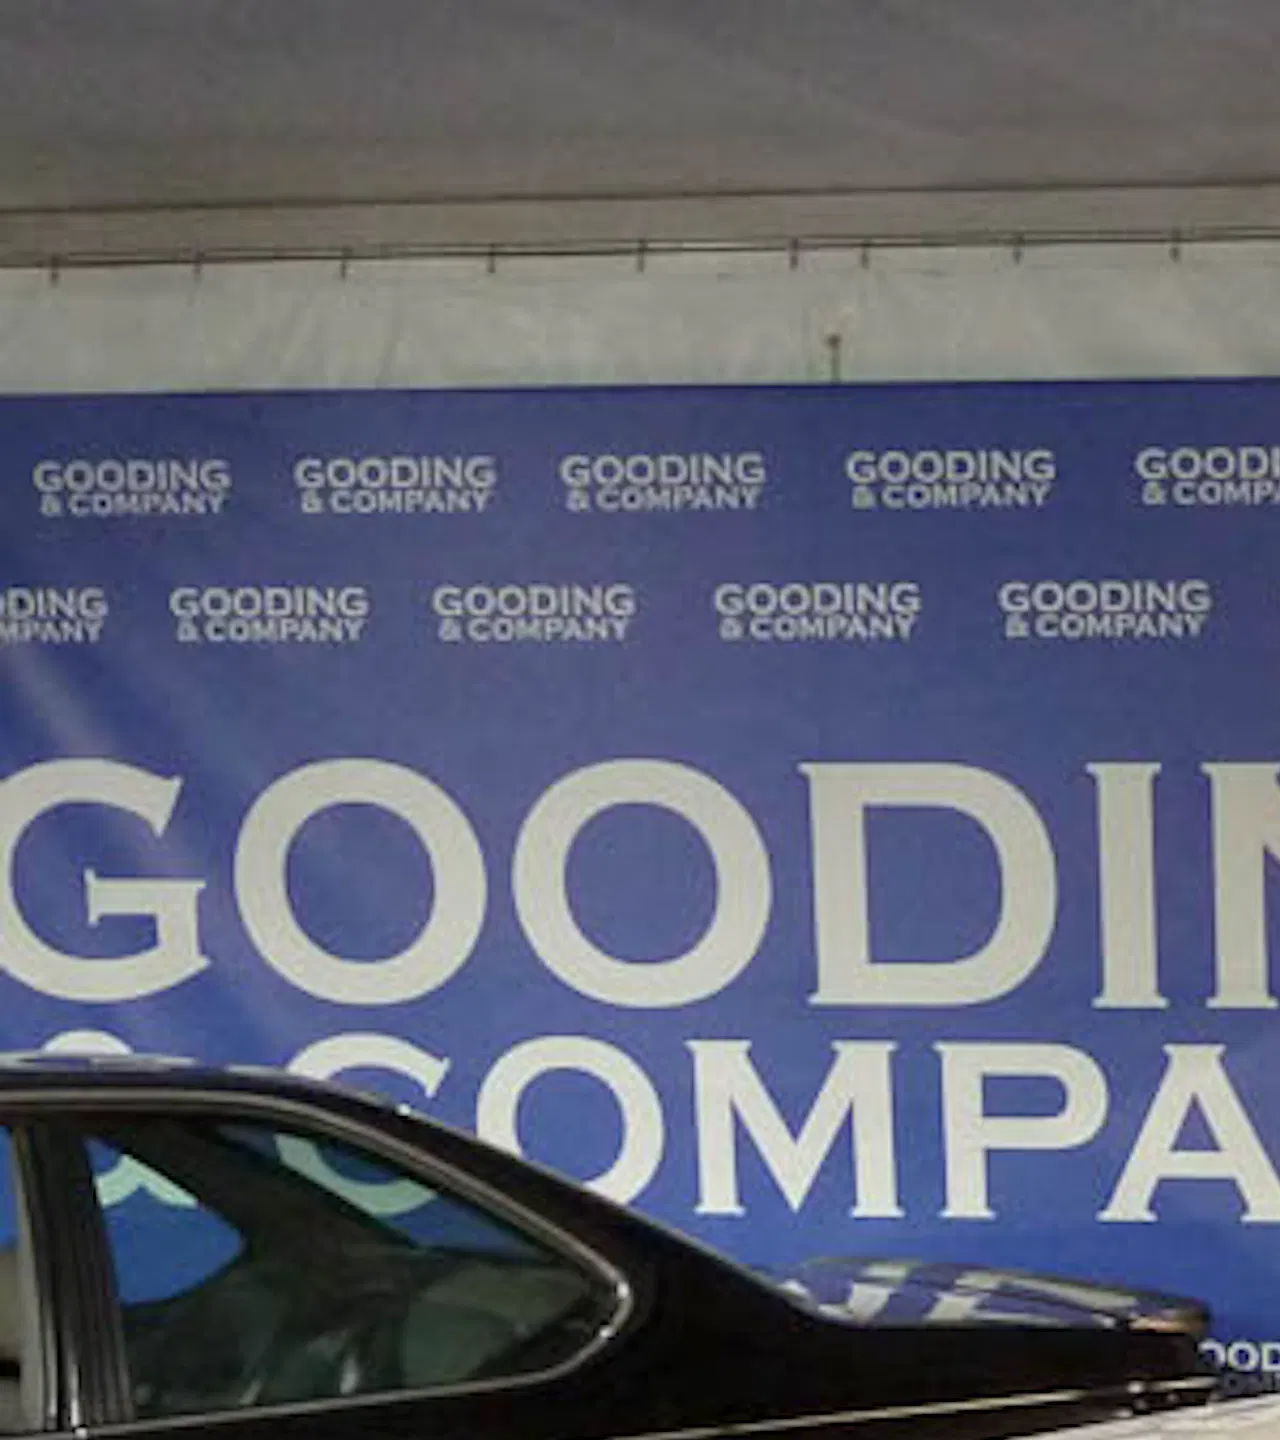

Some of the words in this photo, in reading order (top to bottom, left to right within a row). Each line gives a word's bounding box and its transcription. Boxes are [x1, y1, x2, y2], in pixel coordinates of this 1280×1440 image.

[33, 458, 232, 492] GOODING
[293, 455, 498, 488] GOODING
[559, 452, 767, 486] GOODING
[845, 449, 1057, 483] GOODING
[40, 491, 62, 516] &
[67, 491, 227, 516] COMPANY
[301, 488, 324, 514] &
[329, 488, 492, 514] COMPANY
[565, 484, 591, 511] &
[595, 484, 762, 511] COMPANY
[852, 482, 876, 508] &
[881, 482, 1052, 508] COMPANY
[1142, 479, 1166, 505] &
[0, 587, 109, 618] DING
[169, 586, 370, 618] GOODING
[432, 584, 637, 616] GOODING
[713, 582, 922, 616] GOODING
[998, 579, 1212, 613] GOODING
[177, 616, 199, 642] &
[204, 616, 365, 642] COMPANY
[438, 616, 462, 641] &
[467, 616, 630, 641] COMPANY
[719, 614, 744, 640] &
[749, 614, 917, 640] COMPANY
[1005, 611, 1029, 638] &
[1035, 611, 1207, 638] COMPANY
